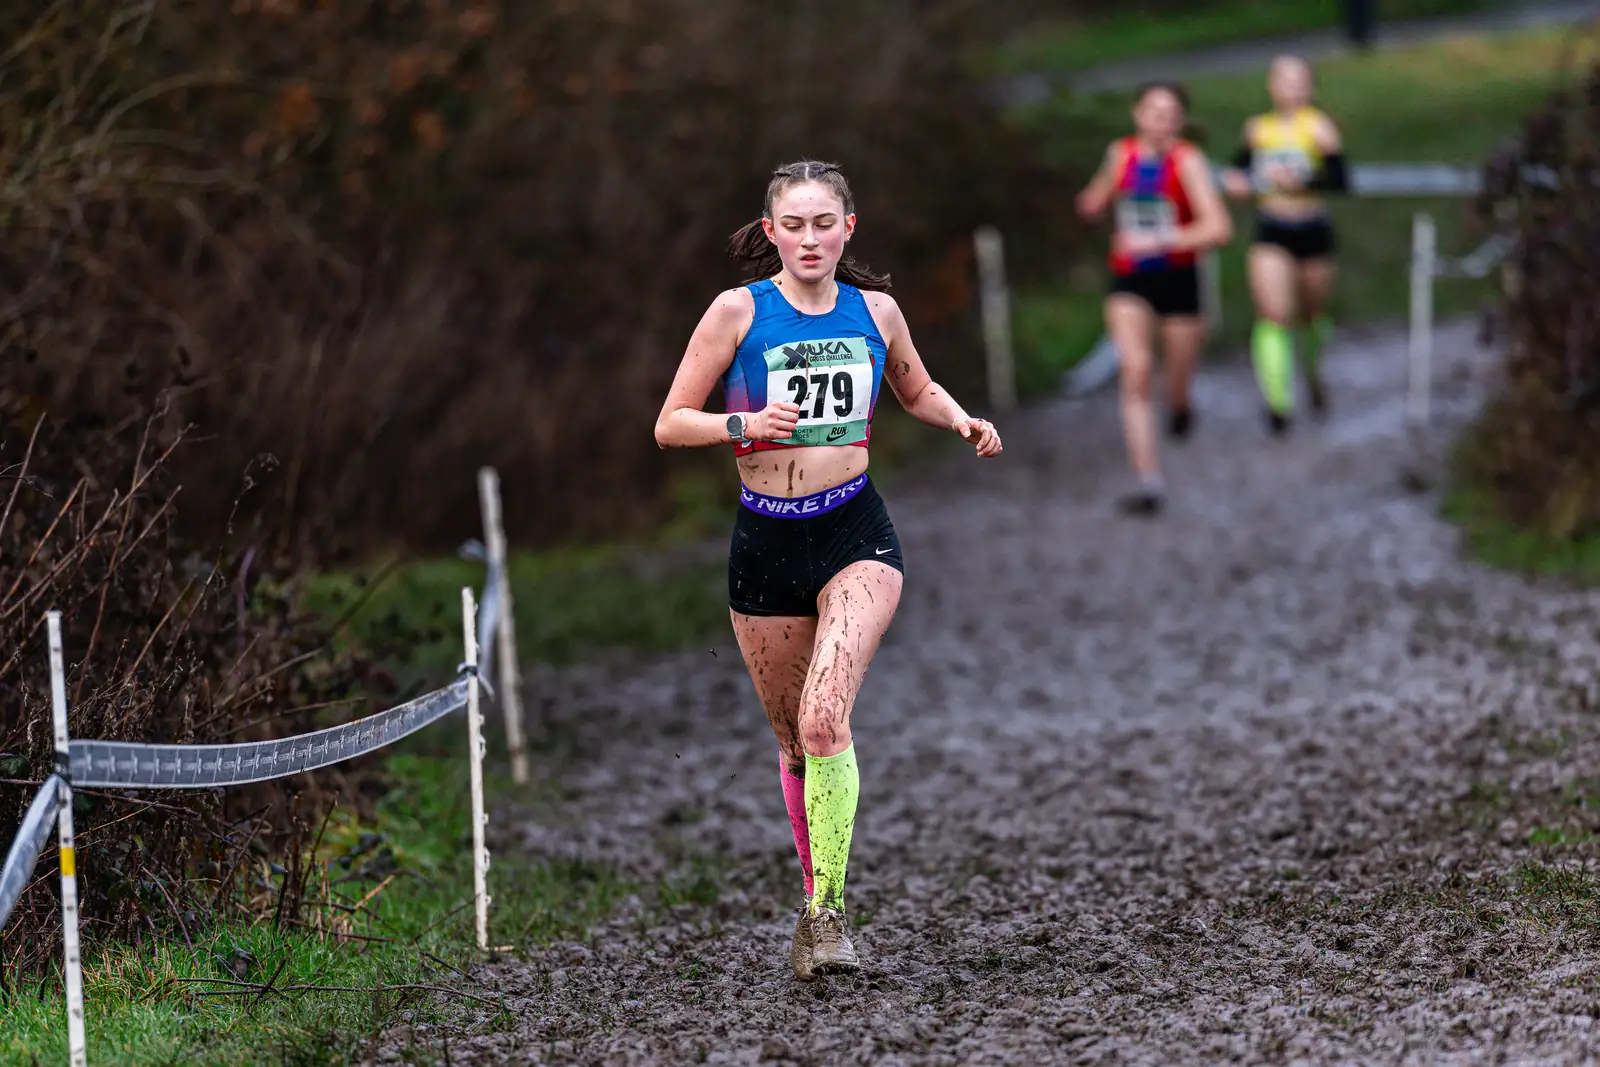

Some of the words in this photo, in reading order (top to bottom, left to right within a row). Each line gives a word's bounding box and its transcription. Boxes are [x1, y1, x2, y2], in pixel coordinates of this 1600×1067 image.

[826, 353, 853, 361] CHALLENGE
[787, 371, 853, 419] 279
[830, 426, 847, 435] RUN
[758, 497, 820, 514] NIKE
